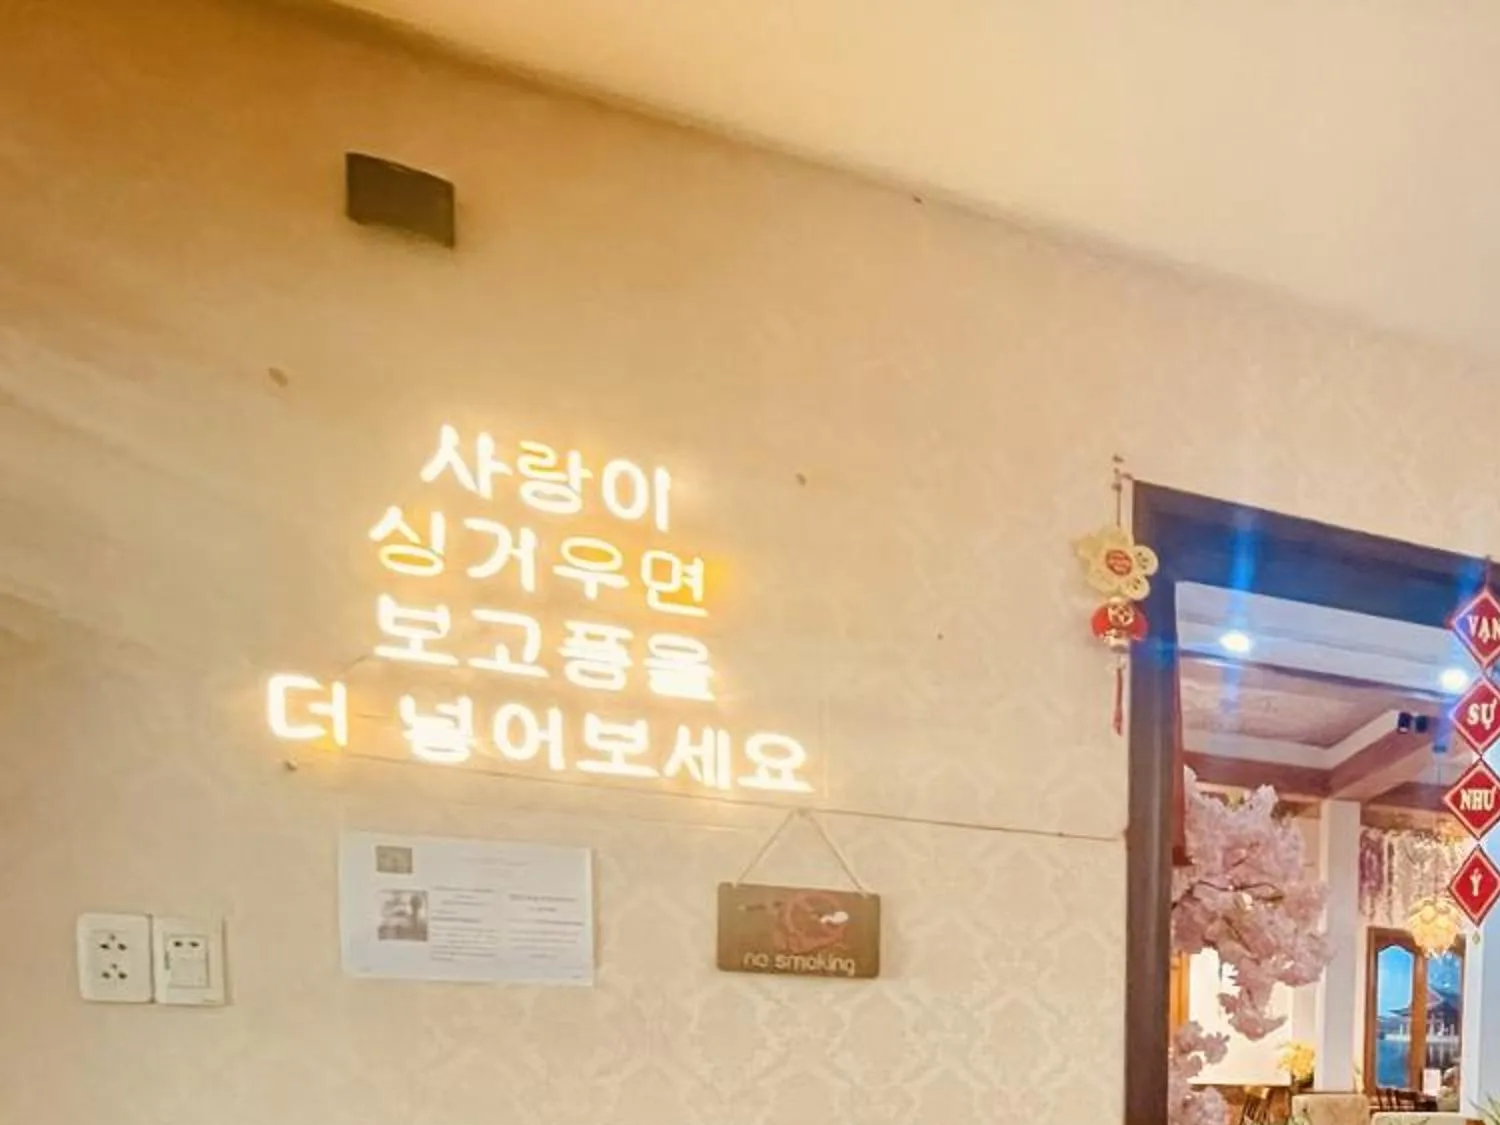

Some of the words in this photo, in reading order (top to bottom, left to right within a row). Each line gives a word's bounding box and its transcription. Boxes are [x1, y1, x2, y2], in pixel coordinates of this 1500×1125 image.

[421, 425, 670, 531] 사랑이
[368, 506, 709, 618] 싱거우면
[267, 673, 349, 747] 더
[1467, 698, 1498, 731] SỰ
[1459, 785, 1497, 812] NHƯ
[743, 952, 769, 968] no
[775, 952, 855, 977] smoking
